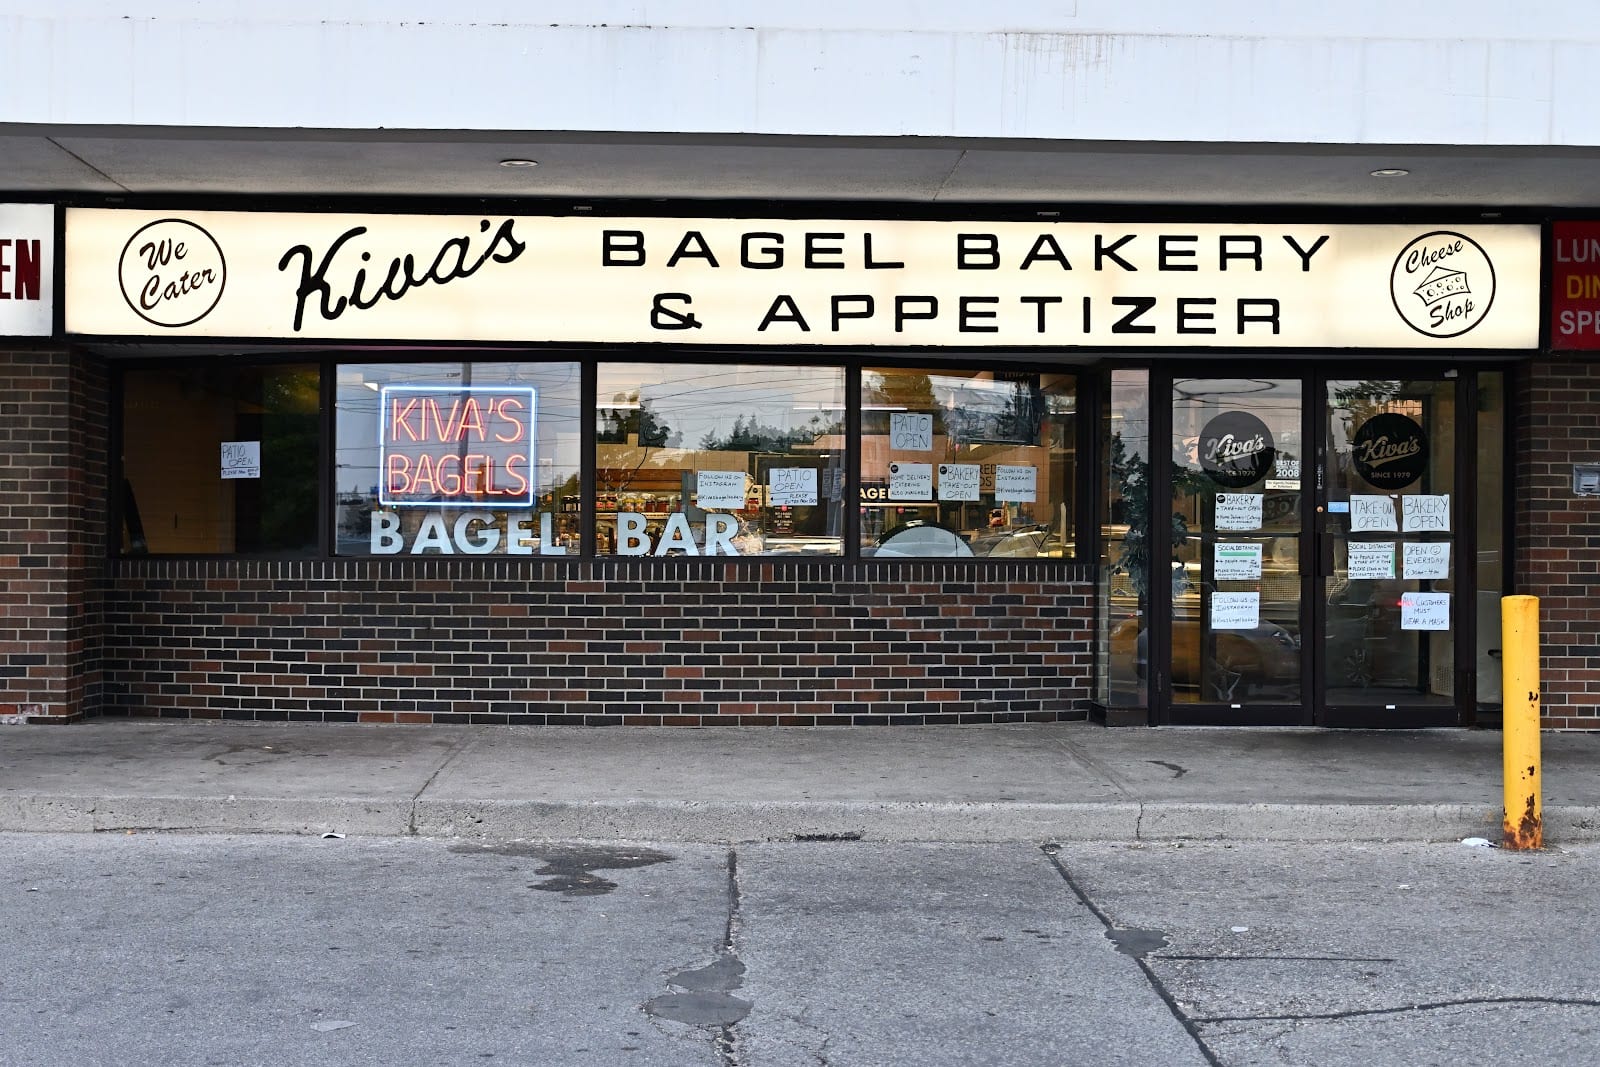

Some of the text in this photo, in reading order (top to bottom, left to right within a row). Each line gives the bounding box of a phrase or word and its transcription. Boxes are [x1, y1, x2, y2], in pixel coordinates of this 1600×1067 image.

[139, 238, 188, 270] We
[602, 230, 1330, 272] BAGEL BAKERY
[1405, 240, 1464, 274] Cheese
[0, 239, 40, 300] EN
[278, 218, 526, 332] Kiva's
[140, 268, 216, 310] Cater
[650, 292, 1280, 334] & APPETIZER
[1429, 298, 1476, 328] Shop
[391, 397, 526, 443] KIVA'S
[893, 414, 928, 431] PATIO
[896, 434, 928, 448] OPEN
[1204, 434, 1266, 460] Kiva's
[1360, 435, 1420, 462] Kiva's
[222, 444, 246, 459] PATIO
[228, 457, 254, 467] OPEN
[387, 454, 528, 496] BAGELS
[777, 469, 812, 482] PATIO
[947, 466, 979, 480] BAKERY
[1276, 469, 1300, 478] 2008
[774, 482, 804, 492] OPEN
[946, 490, 972, 499] OPEN
[1226, 494, 1255, 505] BAKERY
[1404, 497, 1448, 516] BAKERY
[1358, 516, 1389, 528] OPEN
[1410, 515, 1444, 528] OPEN
[370, 511, 566, 555] BAGEL
[616, 512, 742, 556] BAR
[1405, 545, 1428, 556] OPEN
[1406, 556, 1444, 565] EVERYDAY
[1213, 594, 1238, 603] FOLLOW
